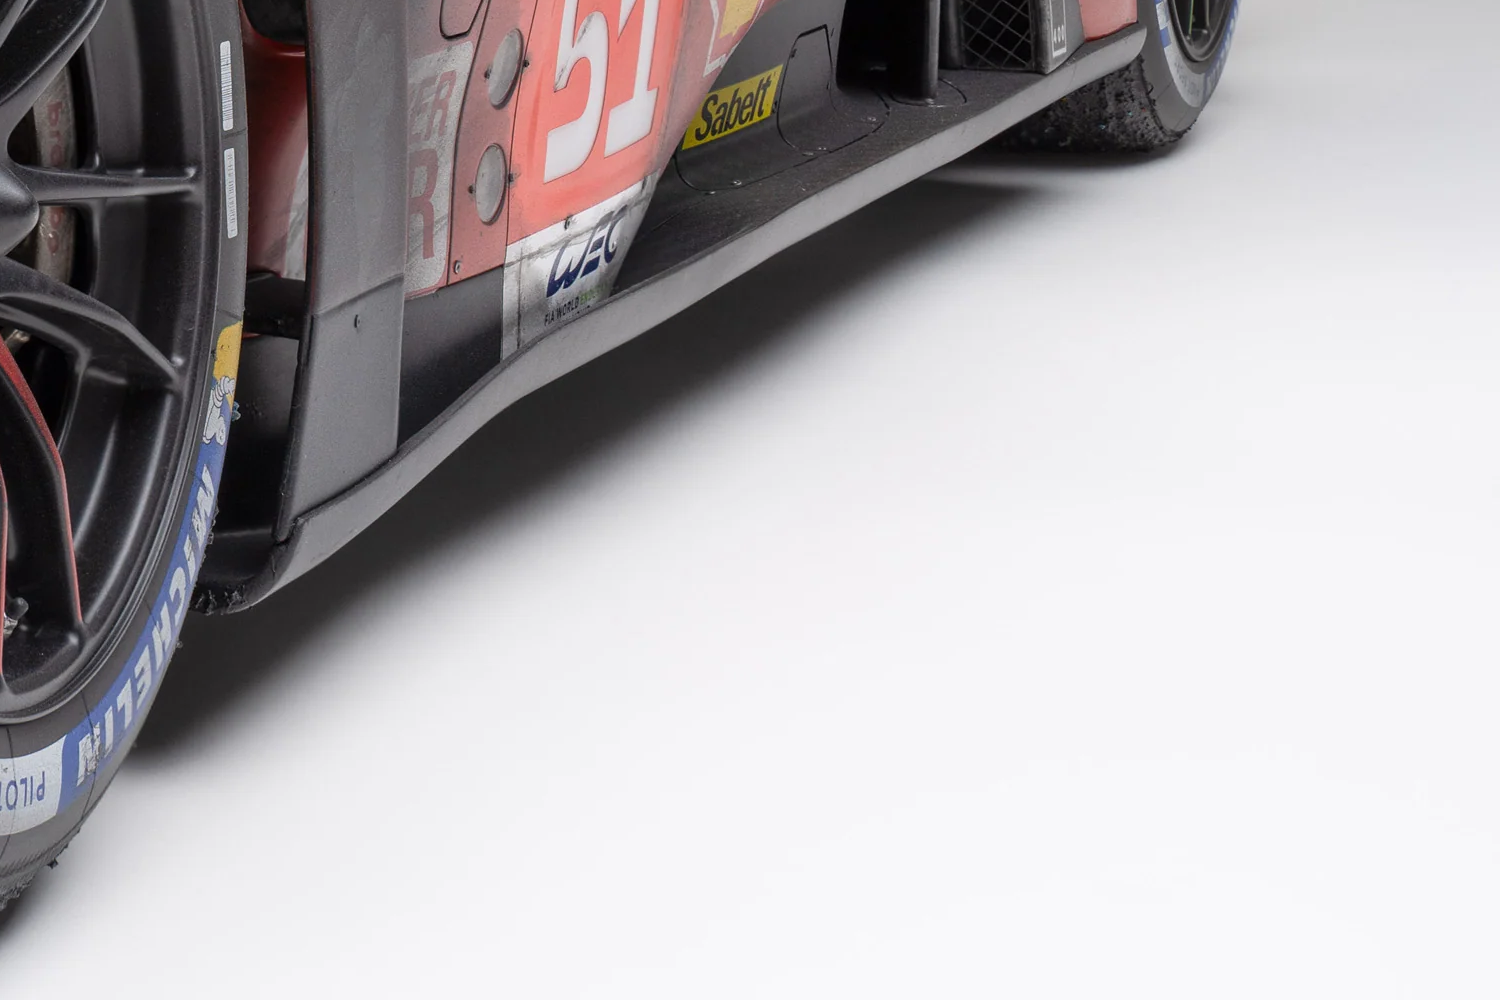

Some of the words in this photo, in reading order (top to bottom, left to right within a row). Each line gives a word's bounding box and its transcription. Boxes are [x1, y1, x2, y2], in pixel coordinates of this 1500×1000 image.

[695, 77, 771, 141] Sabelt
[546, 204, 629, 298] WEC
[77, 463, 215, 788] MICHELIN
